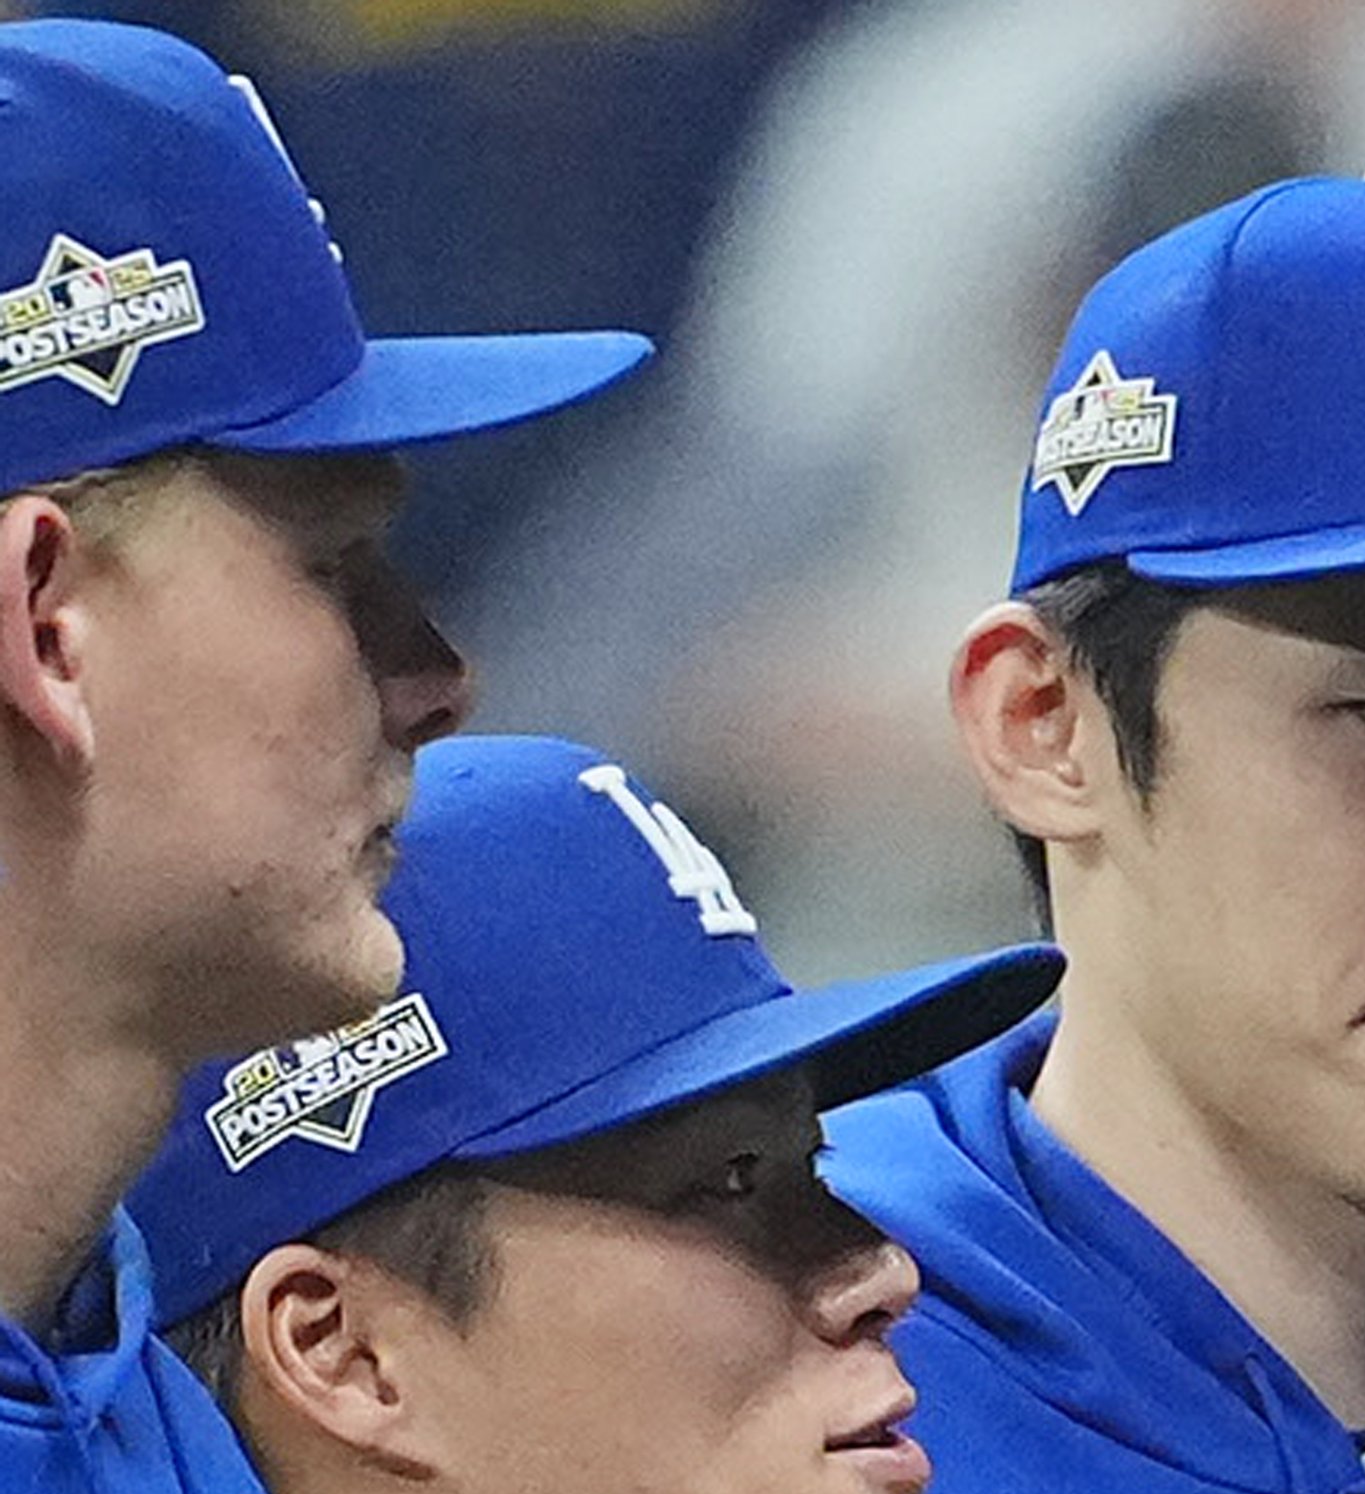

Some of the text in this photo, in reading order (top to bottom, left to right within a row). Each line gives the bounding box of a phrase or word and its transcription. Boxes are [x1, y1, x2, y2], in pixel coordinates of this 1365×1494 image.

[0, 283, 192, 368] OSTSEASON
[578, 764, 758, 935] LA
[218, 1014, 430, 1150] POSTSEASON
